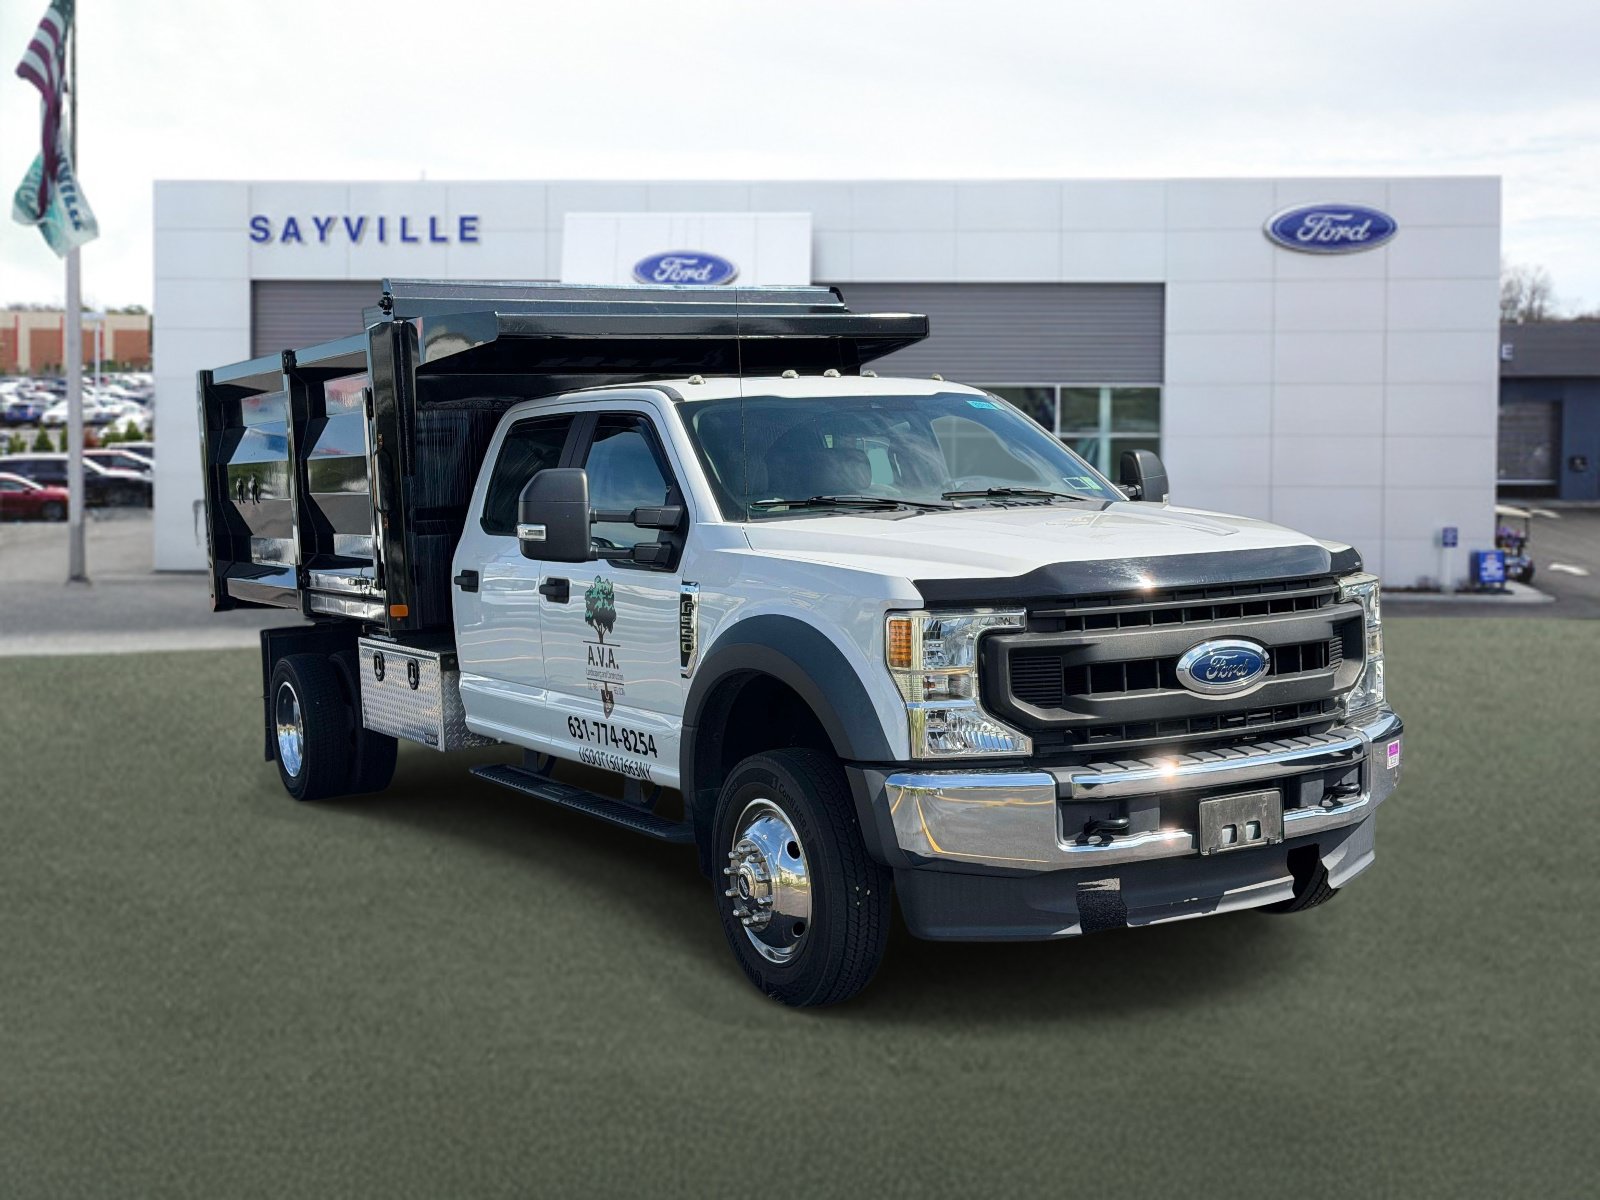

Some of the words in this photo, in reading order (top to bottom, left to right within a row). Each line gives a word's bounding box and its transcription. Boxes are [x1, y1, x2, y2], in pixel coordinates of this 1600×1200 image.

[249, 215, 479, 243] SAYVILLE
[1297, 213, 1372, 241] Ford
[653, 257, 713, 282] Ford
[588, 645, 620, 669] A.V.A.
[1206, 654, 1248, 680] Ford
[567, 715, 658, 758] 631-774-8254
